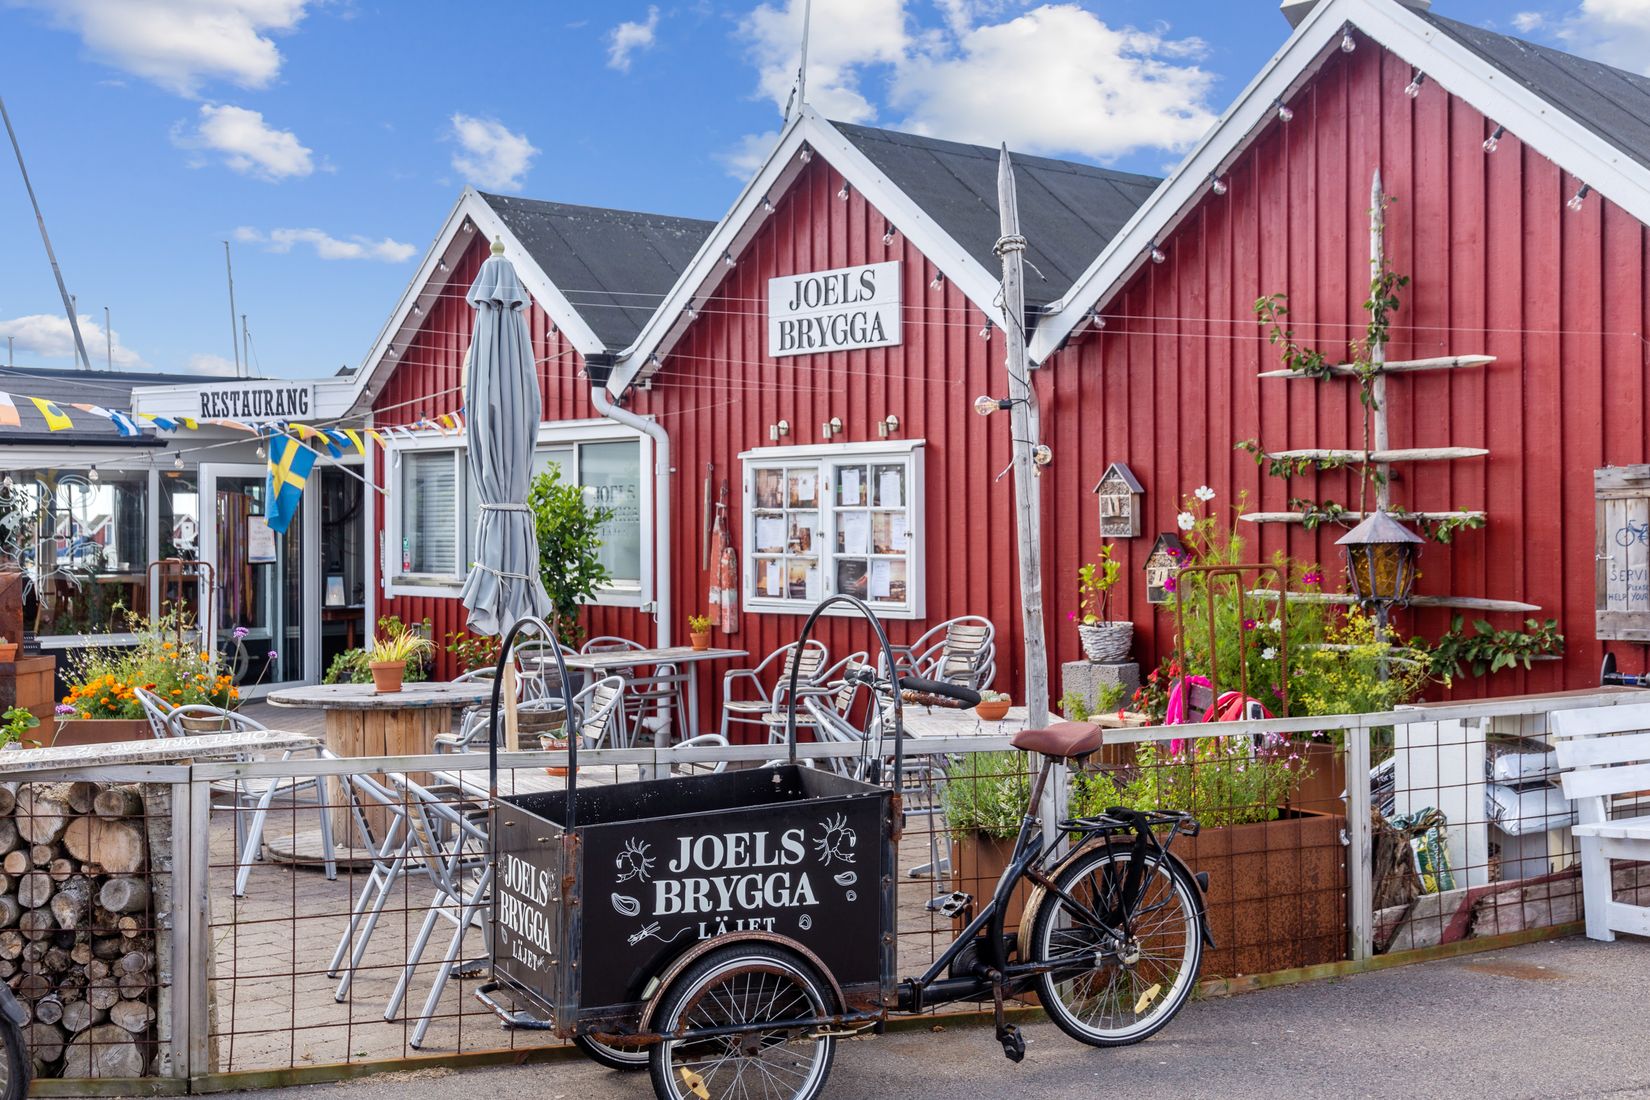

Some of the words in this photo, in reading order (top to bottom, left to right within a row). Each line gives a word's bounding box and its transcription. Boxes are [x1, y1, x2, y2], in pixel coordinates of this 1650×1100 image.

[789, 269, 876, 311] JOELS
[778, 311, 888, 351] BRYGGA
[200, 388, 308, 418] RESTAURANG
[669, 829, 805, 873] JOELS
[505, 854, 548, 907] JOELS
[652, 872, 819, 915] BRYGGA
[499, 889, 552, 954] BRYGGA
[512, 939, 538, 971] LÄJET
